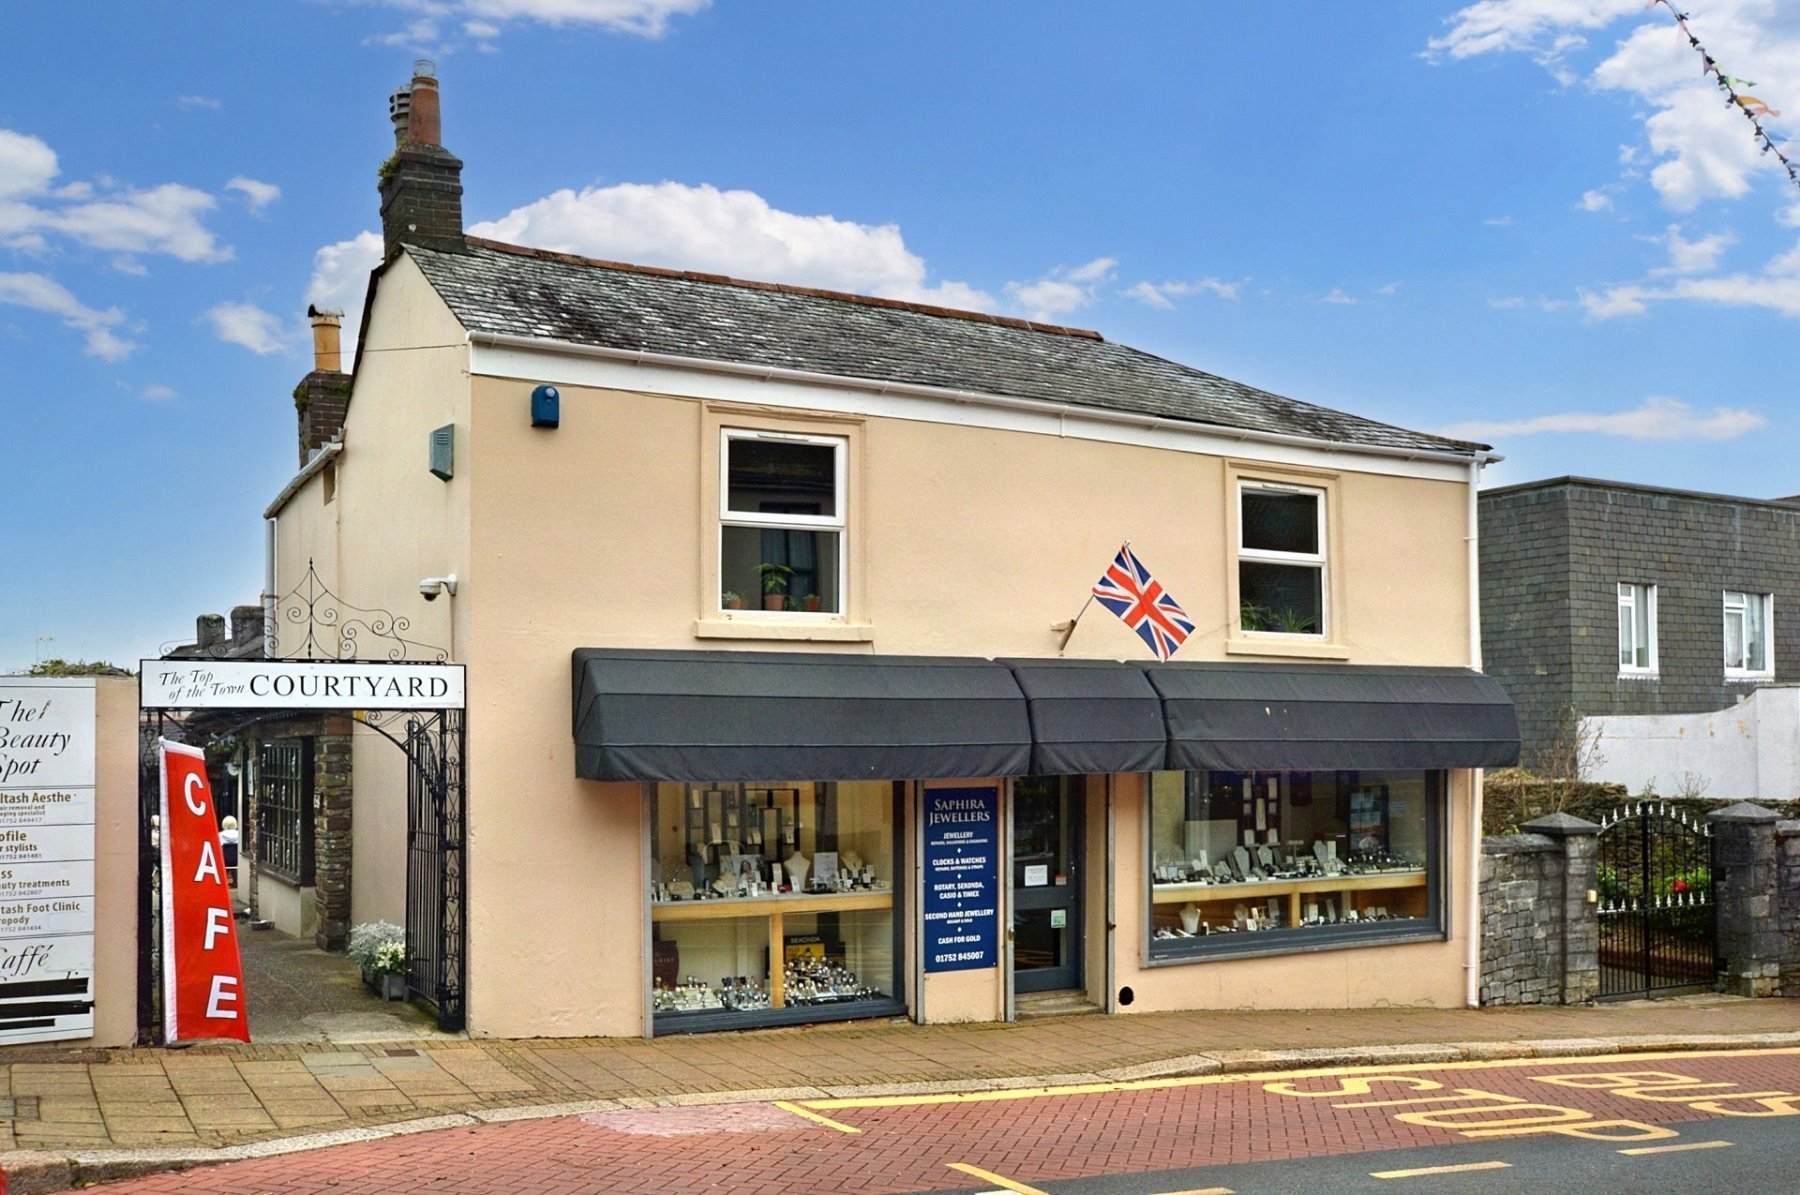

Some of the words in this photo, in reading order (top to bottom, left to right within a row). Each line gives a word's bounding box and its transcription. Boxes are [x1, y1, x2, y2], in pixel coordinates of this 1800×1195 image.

[159, 672, 185, 686] The
[190, 669, 214, 687] Top
[249, 674, 449, 697] COURTYARD
[168, 685, 186, 704] of
[186, 684, 206, 698] the
[210, 682, 245, 696] Town
[934, 798, 986, 811] SAPHIRA
[929, 811, 991, 827] JEWELLERS
[932, 858, 954, 866] CLOCKS
[960, 856, 987, 864] WATCHES
[18, 879, 70, 889] treatments
[183, 771, 239, 1020] CAFE
[27, 903, 50, 913] Foot
[52, 901, 81, 911] Clinic
[925, 912, 948, 920] SECOND
[948, 911, 964, 919] HAND
[964, 909, 995, 918] JEWELLERY
[937, 936, 954, 945] CASH
[965, 935, 981, 943] GOLD
[935, 953, 957, 963] 01752
[957, 951, 985, 962] 845007
